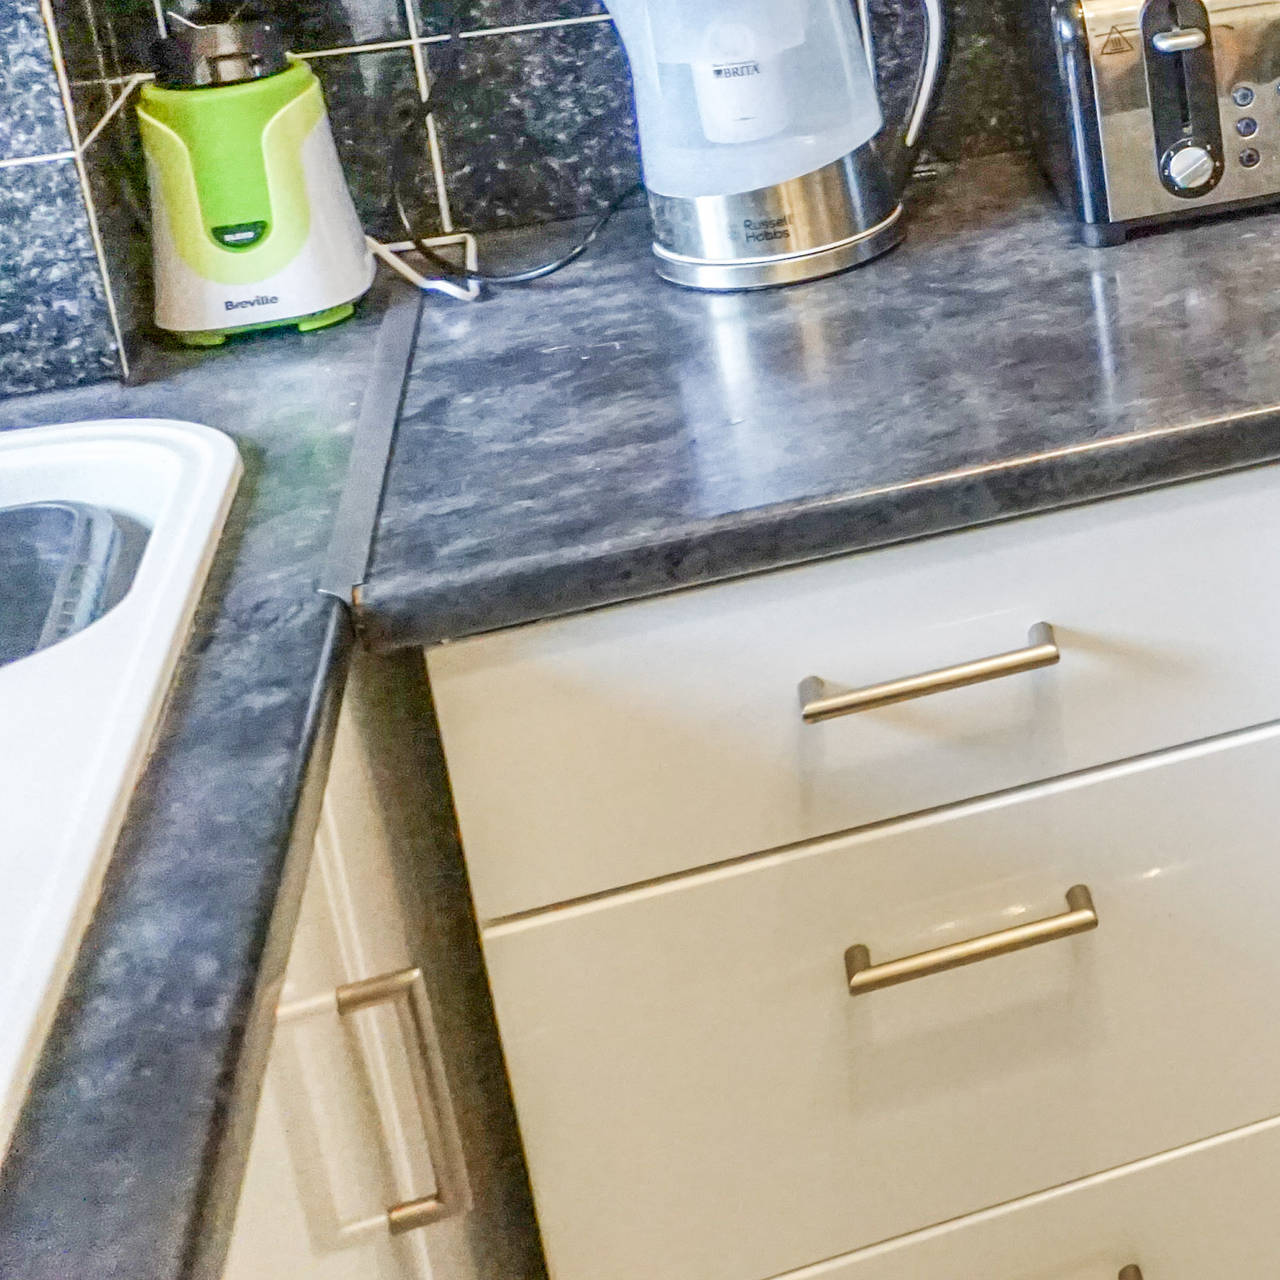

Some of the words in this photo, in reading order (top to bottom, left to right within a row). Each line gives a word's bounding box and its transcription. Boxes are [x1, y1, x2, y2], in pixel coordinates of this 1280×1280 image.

[724, 63, 761, 78] BRITA
[745, 229, 790, 242] Hobbs
[224, 295, 279, 311] Breville
